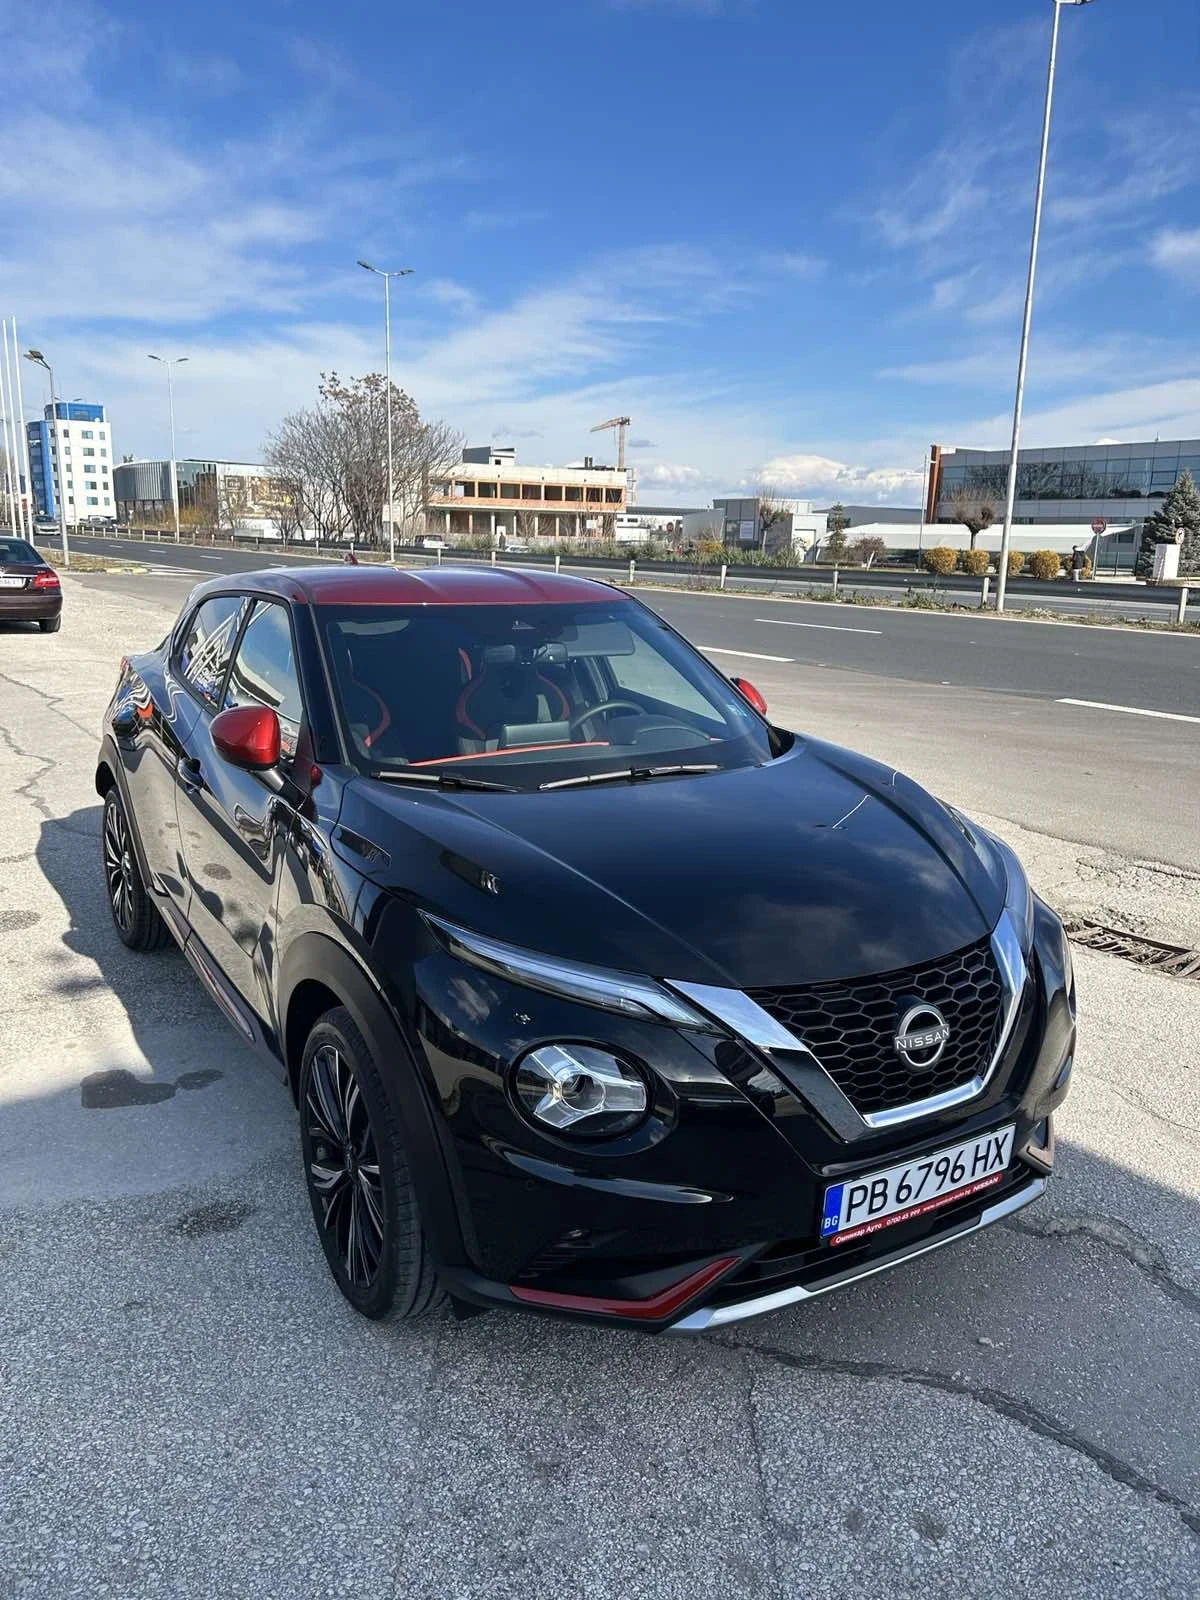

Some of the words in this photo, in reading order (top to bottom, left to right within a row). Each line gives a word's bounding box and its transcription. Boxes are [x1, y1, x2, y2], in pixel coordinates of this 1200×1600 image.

[896, 1026, 949, 1050] NISSAN
[845, 1178, 888, 1223] PB
[896, 1150, 965, 1203] 6796
[972, 1133, 1010, 1177] HX
[824, 1216, 839, 1229] BG
